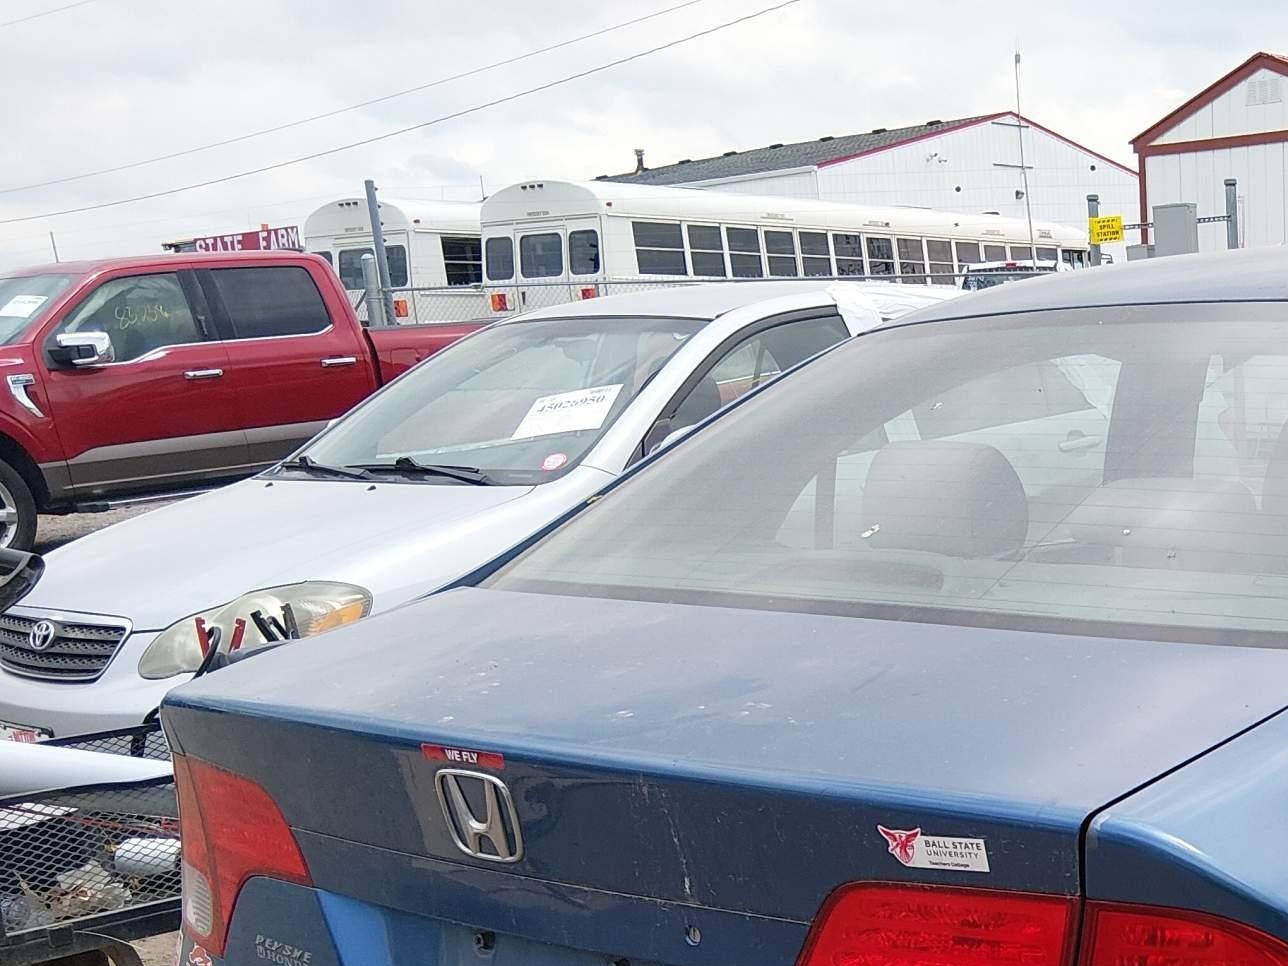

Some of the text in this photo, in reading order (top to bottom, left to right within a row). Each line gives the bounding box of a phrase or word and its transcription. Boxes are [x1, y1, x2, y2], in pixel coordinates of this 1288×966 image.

[195, 227, 299, 252] STATE FARM
[444, 749, 478, 764] WE FLY
[924, 839, 983, 851] BALL STATE
[926, 850, 979, 859] UNIVERSITY
